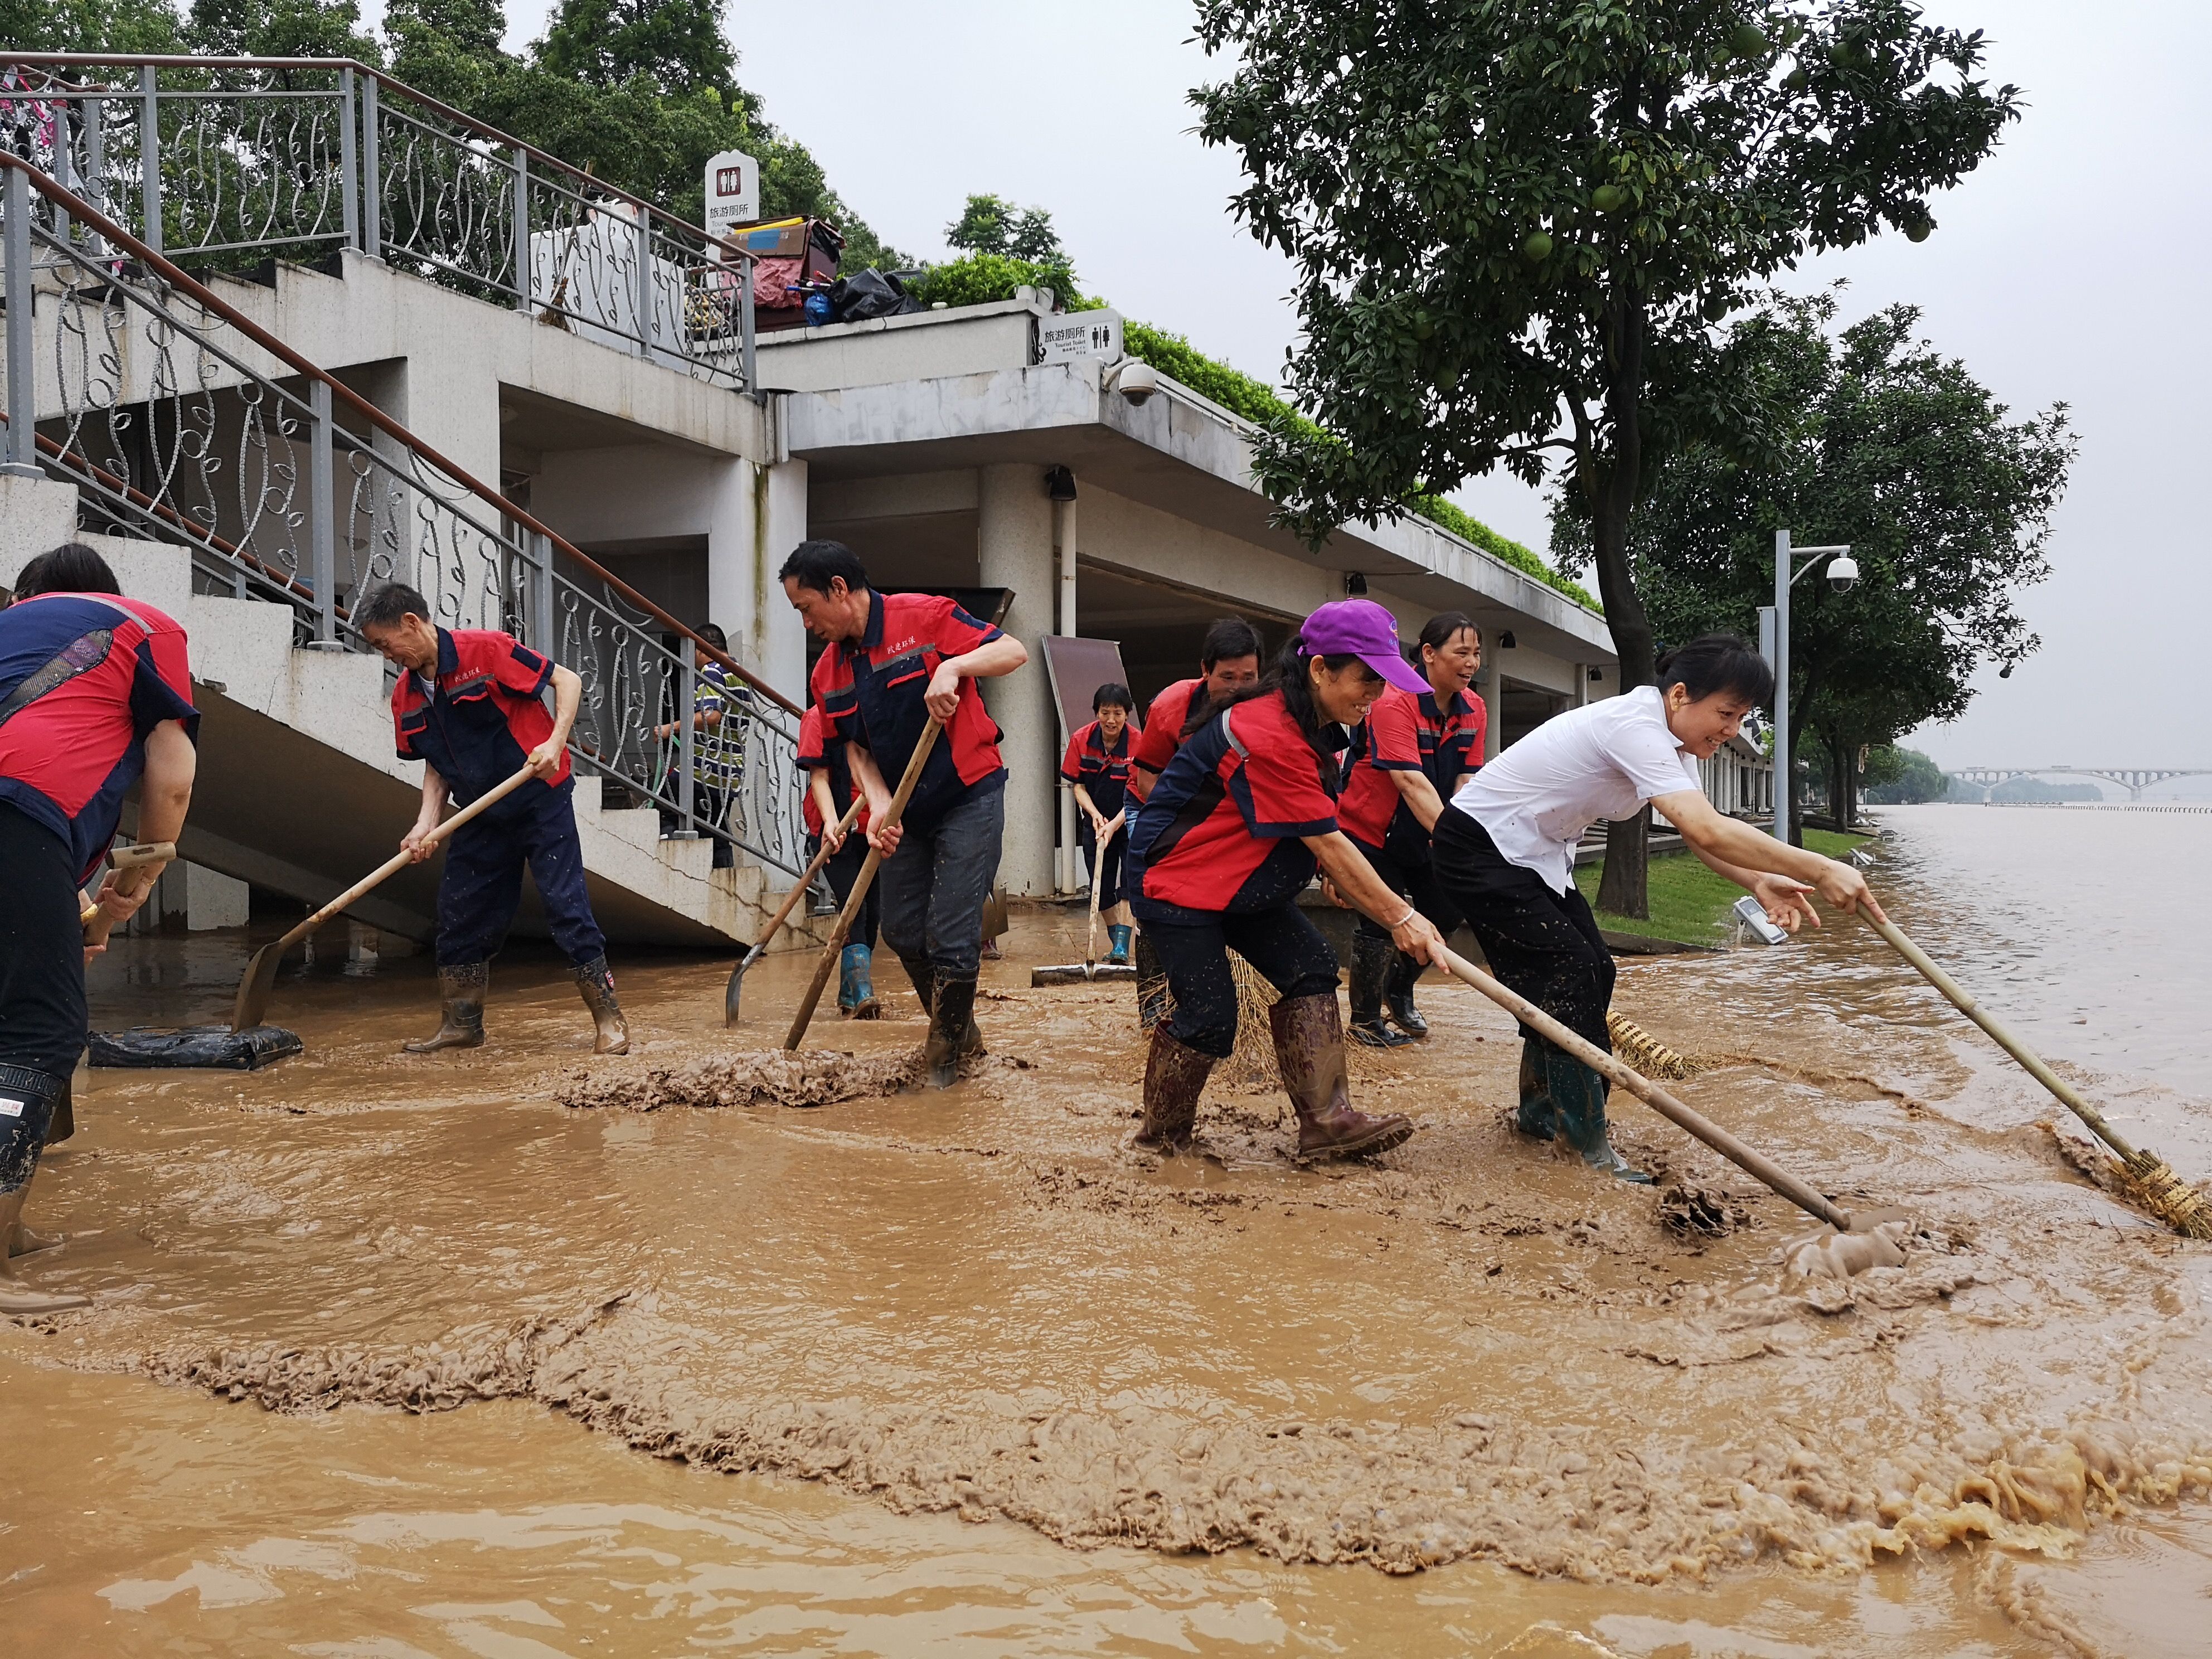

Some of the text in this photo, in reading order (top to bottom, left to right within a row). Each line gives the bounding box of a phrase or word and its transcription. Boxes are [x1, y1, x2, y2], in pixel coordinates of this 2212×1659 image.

[710, 203, 749, 219] 旅游厕所
[1045, 326, 1085, 343] 旅游厕所
